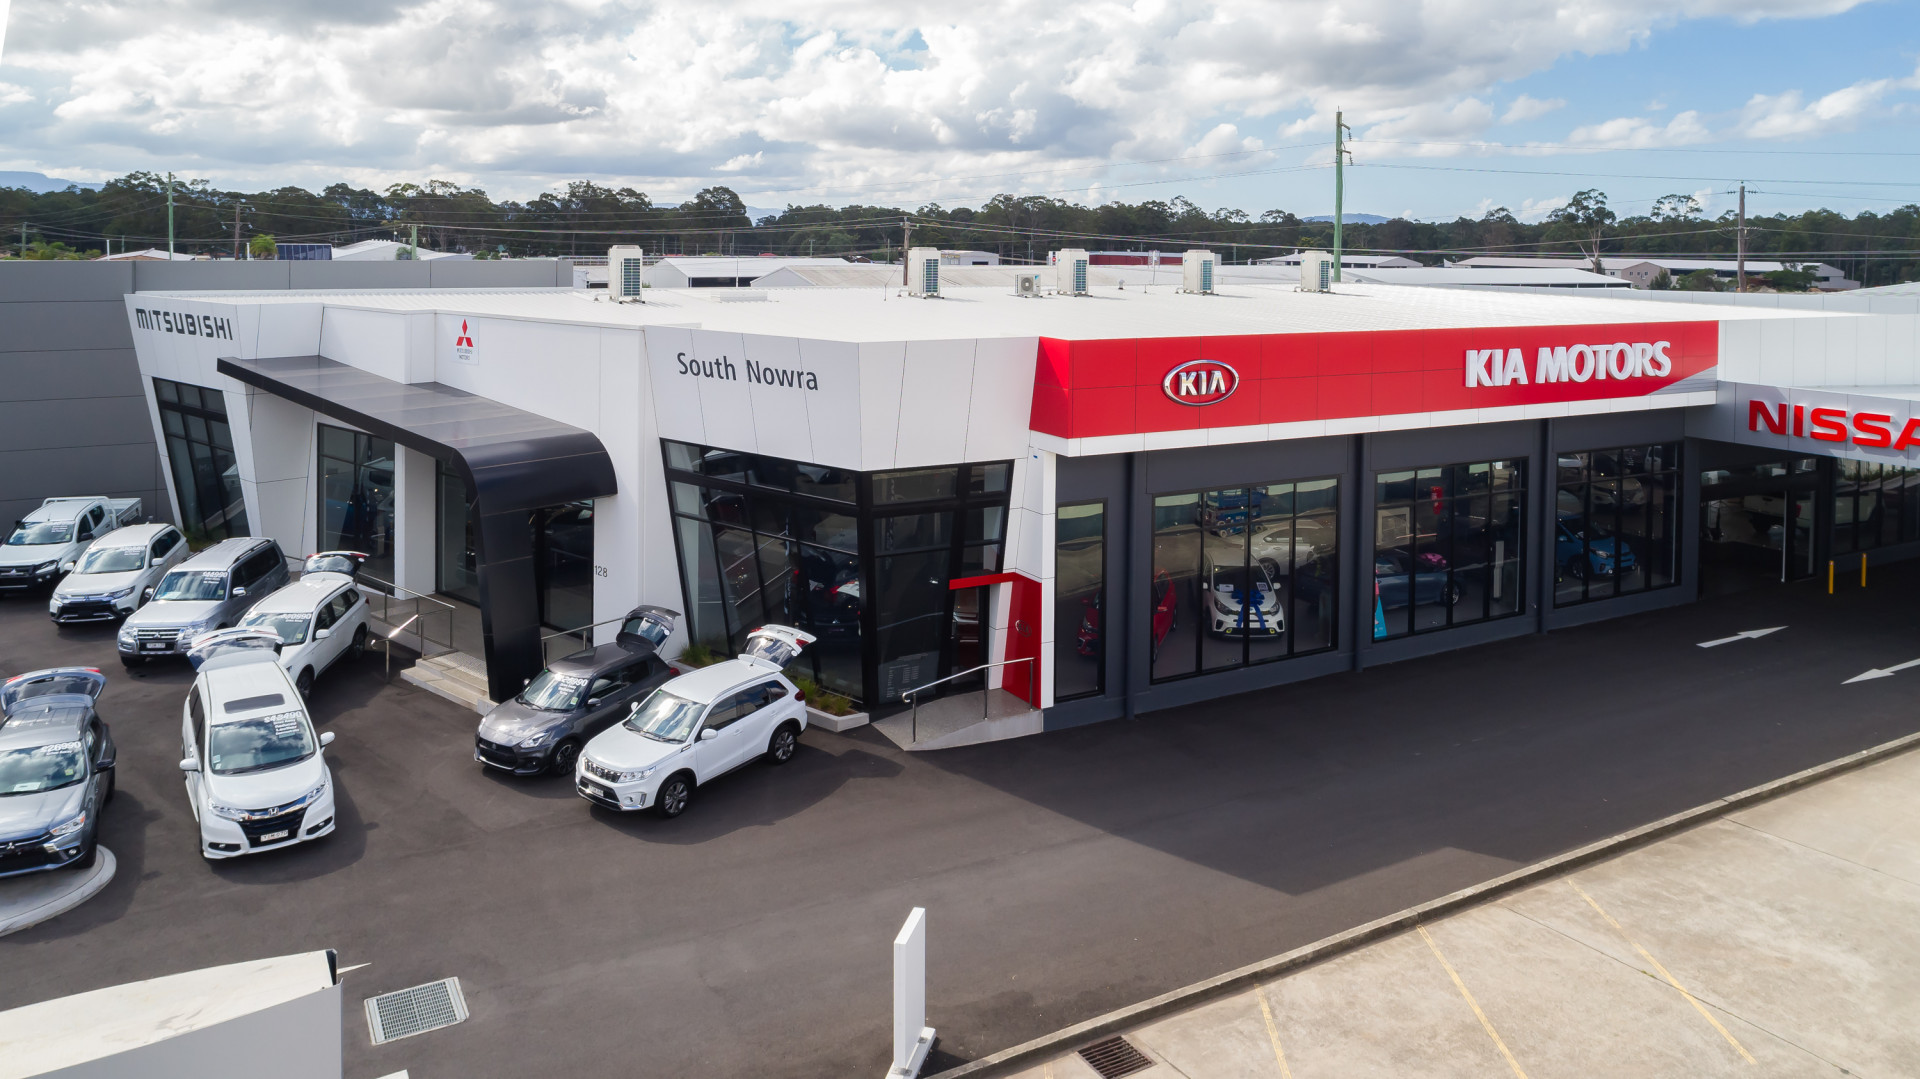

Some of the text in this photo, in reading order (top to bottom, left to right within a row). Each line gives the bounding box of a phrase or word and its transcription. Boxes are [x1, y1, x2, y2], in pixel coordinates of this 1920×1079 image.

[135, 308, 233, 341] MITSUBISHI
[676, 352, 819, 391] South Nowra
[1465, 340, 1672, 388] KIA MOTORS
[1178, 370, 1226, 396] KIA
[594, 564, 608, 578] 128
